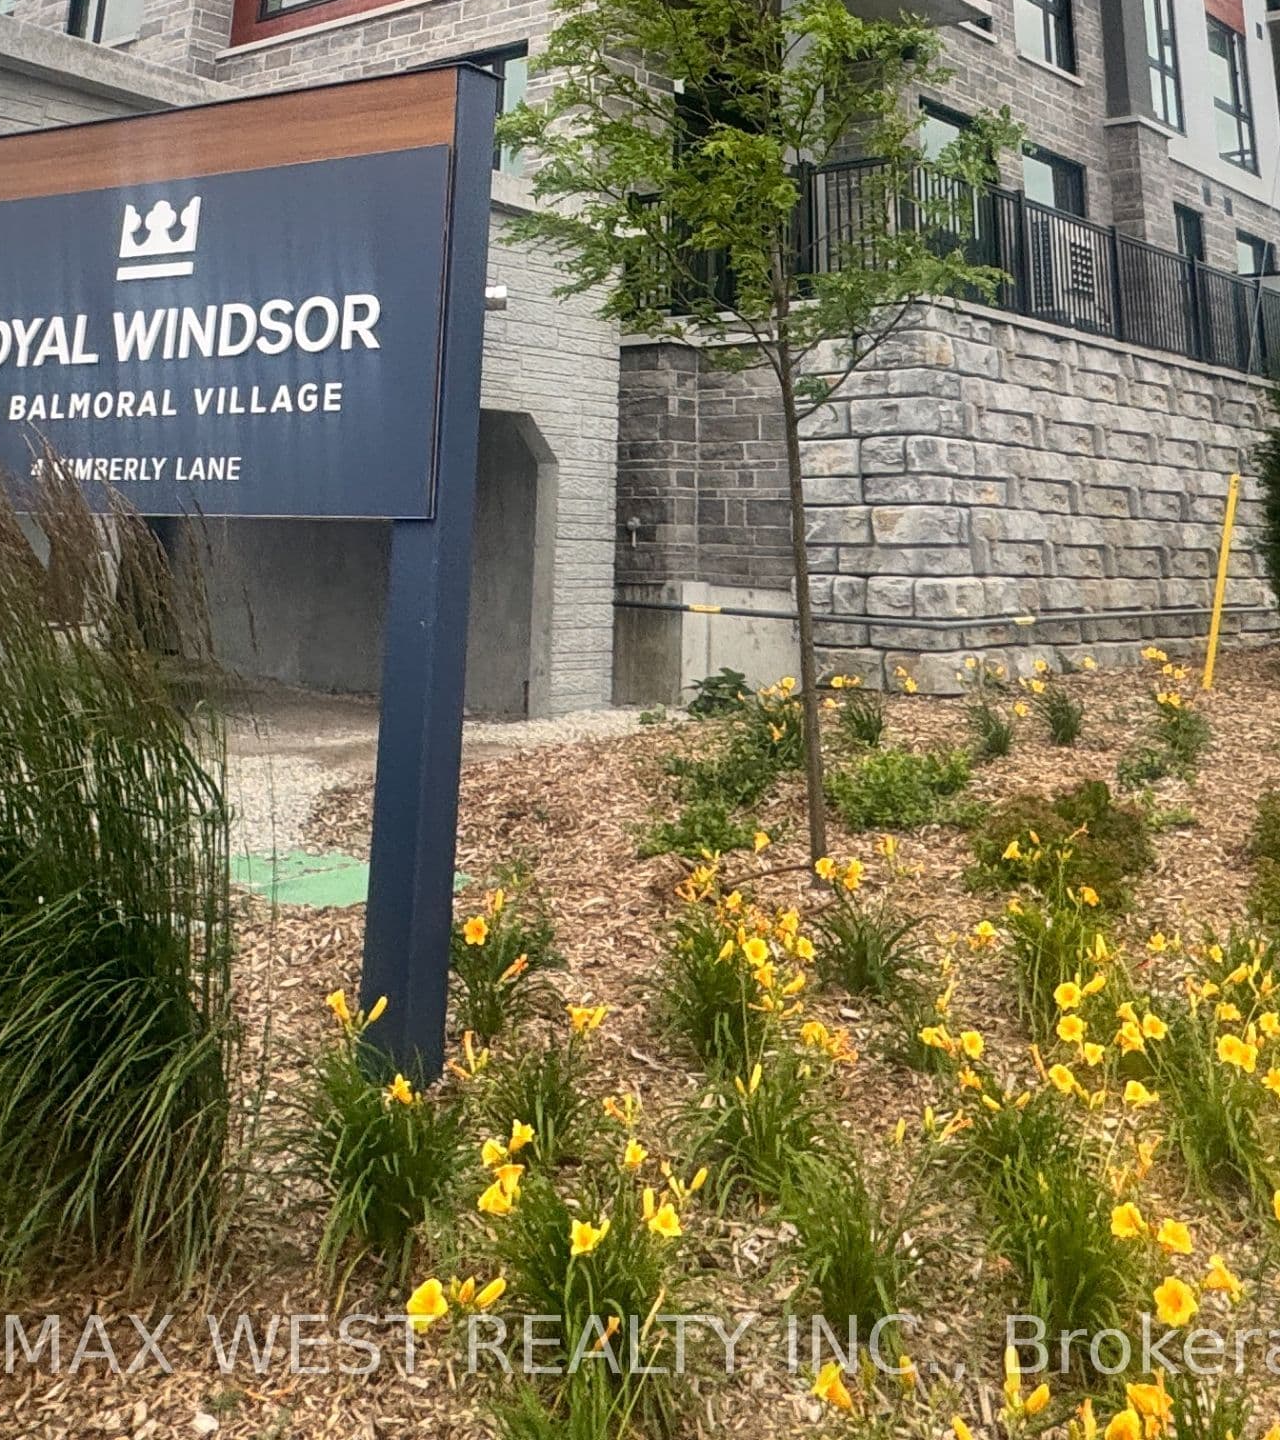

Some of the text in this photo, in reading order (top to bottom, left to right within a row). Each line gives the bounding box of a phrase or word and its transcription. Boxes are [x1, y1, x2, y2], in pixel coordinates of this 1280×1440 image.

[114, 294, 381, 362] WINDSOR
[8, 390, 177, 421] BALMORAL
[194, 382, 343, 415] VILLAGE
[175, 456, 242, 481] LANE
